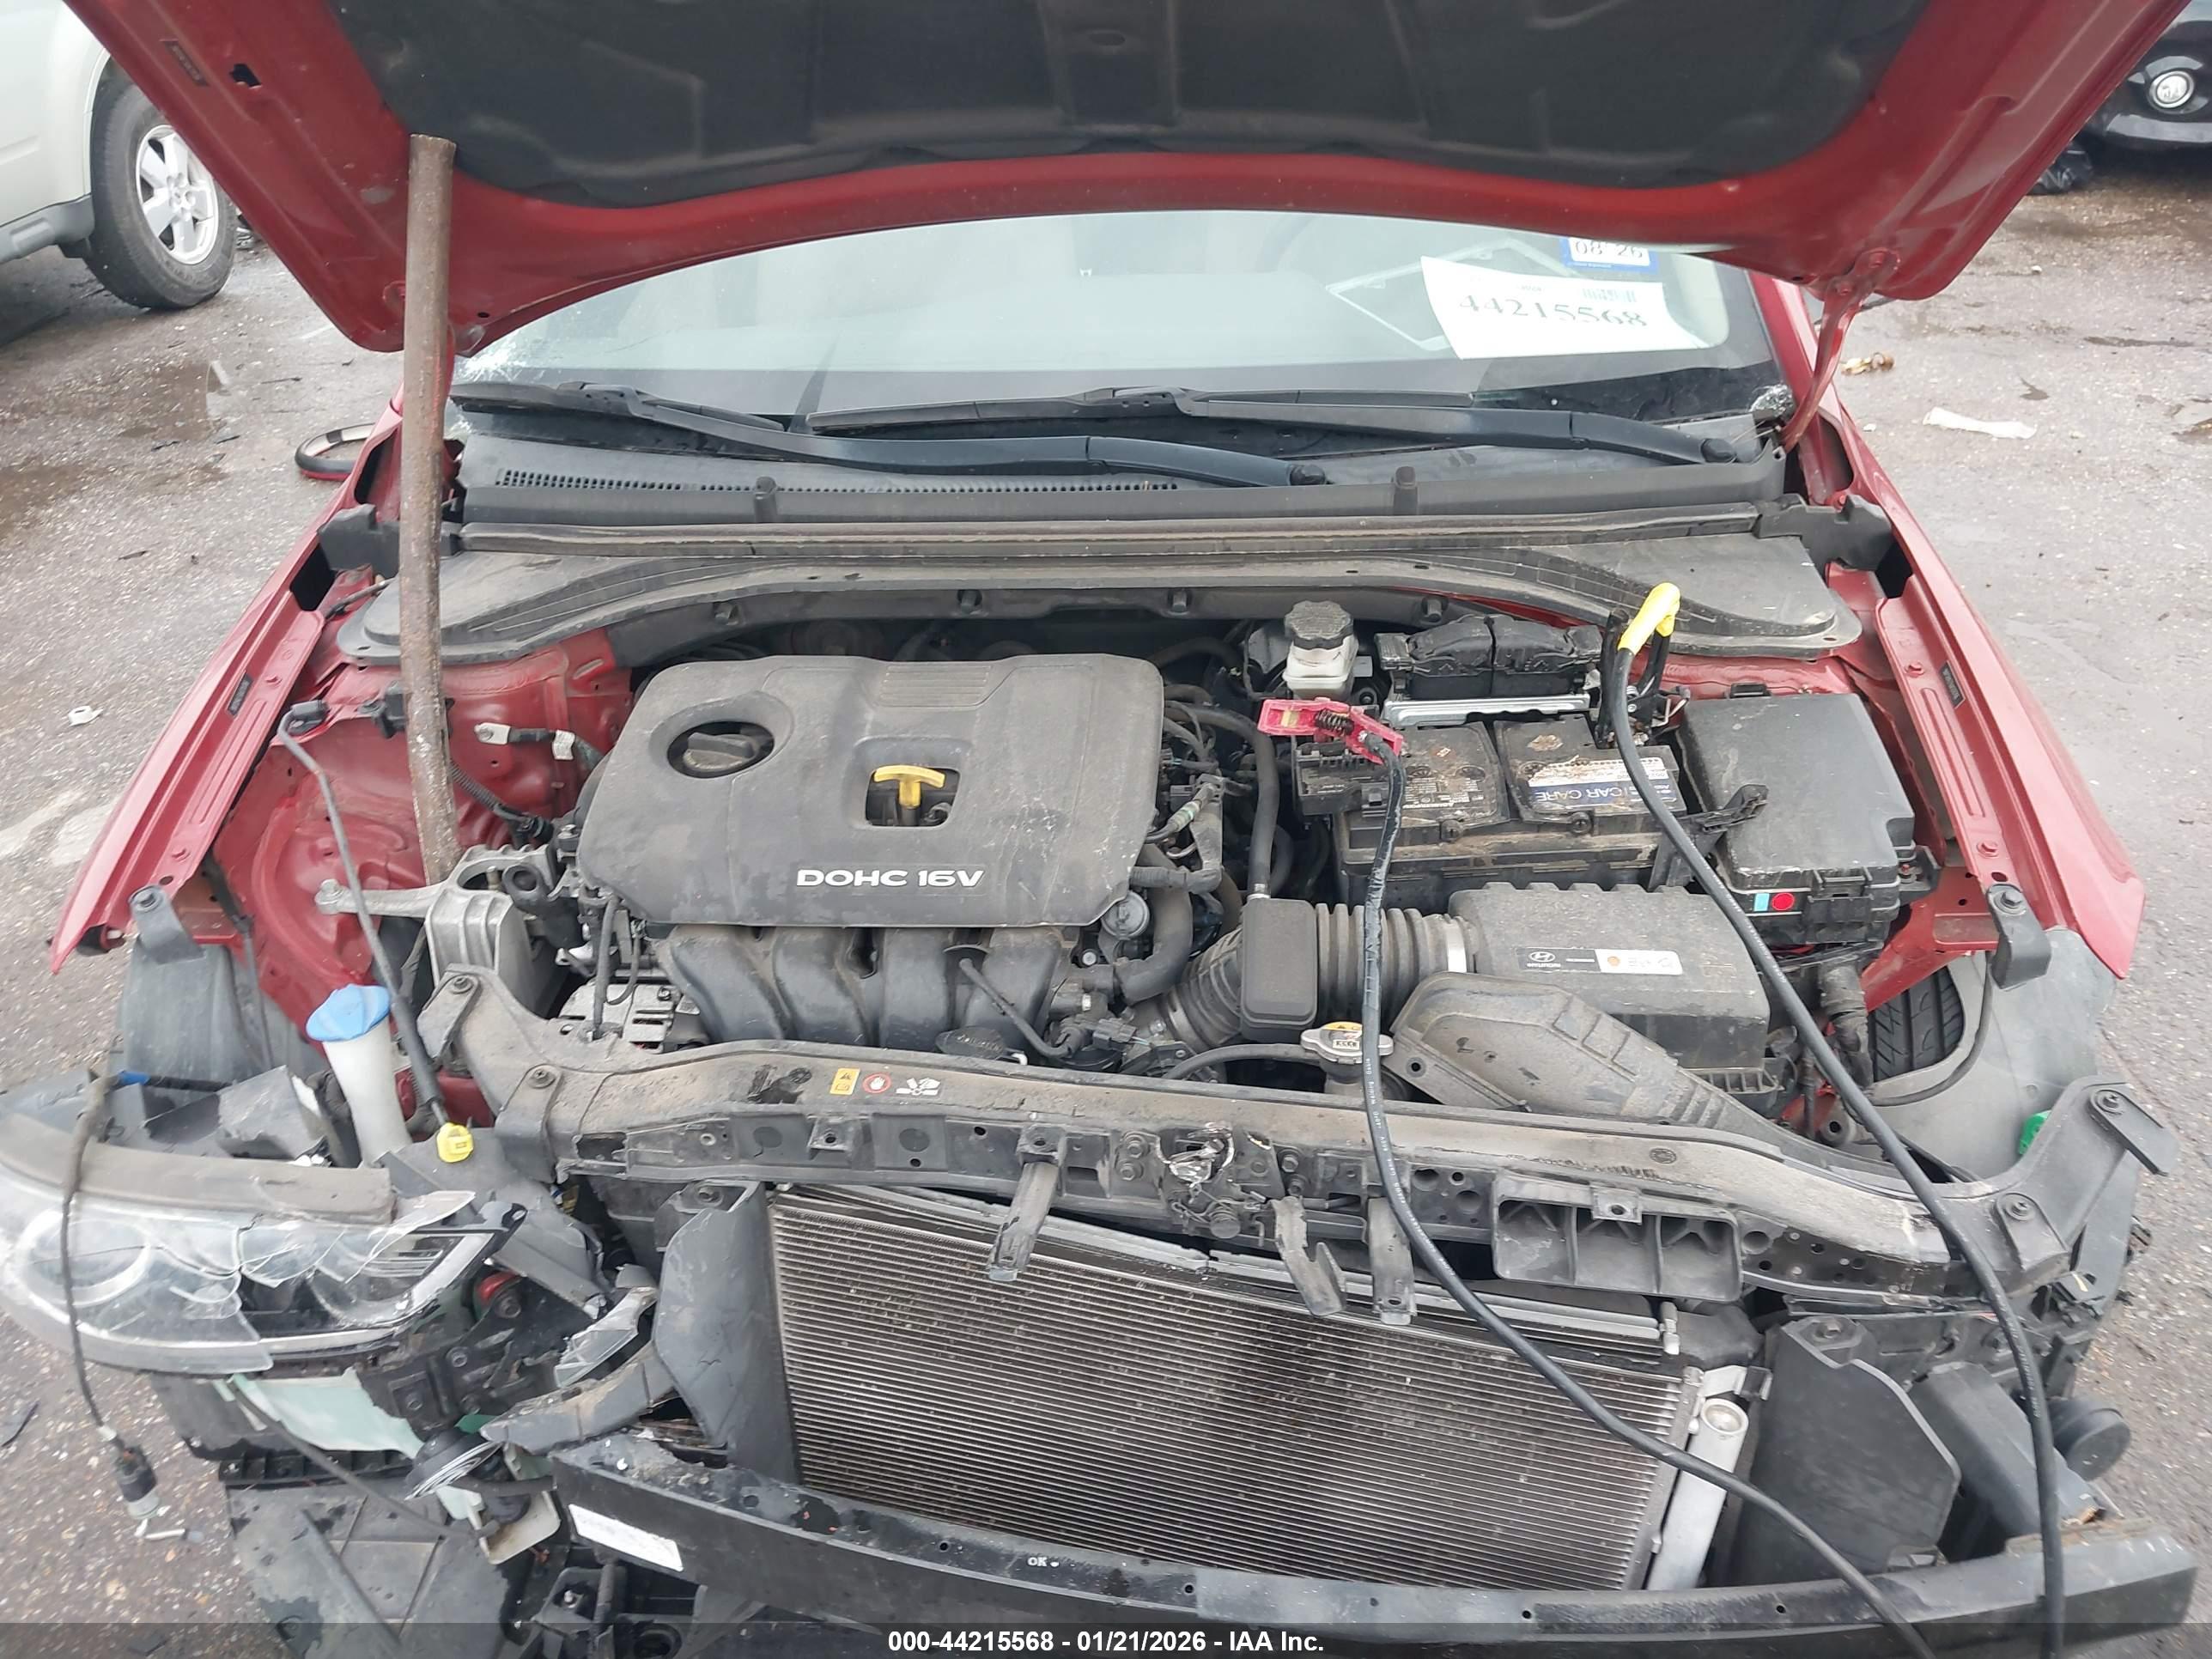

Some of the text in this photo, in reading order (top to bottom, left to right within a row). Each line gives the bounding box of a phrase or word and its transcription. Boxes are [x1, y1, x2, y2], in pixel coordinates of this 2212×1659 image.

[1459, 294, 1648, 327] 44215568
[1534, 786, 1623, 802] CAR CARE
[796, 869, 984, 887] DOHC 16V
[1027, 1556, 1048, 1567] OK
